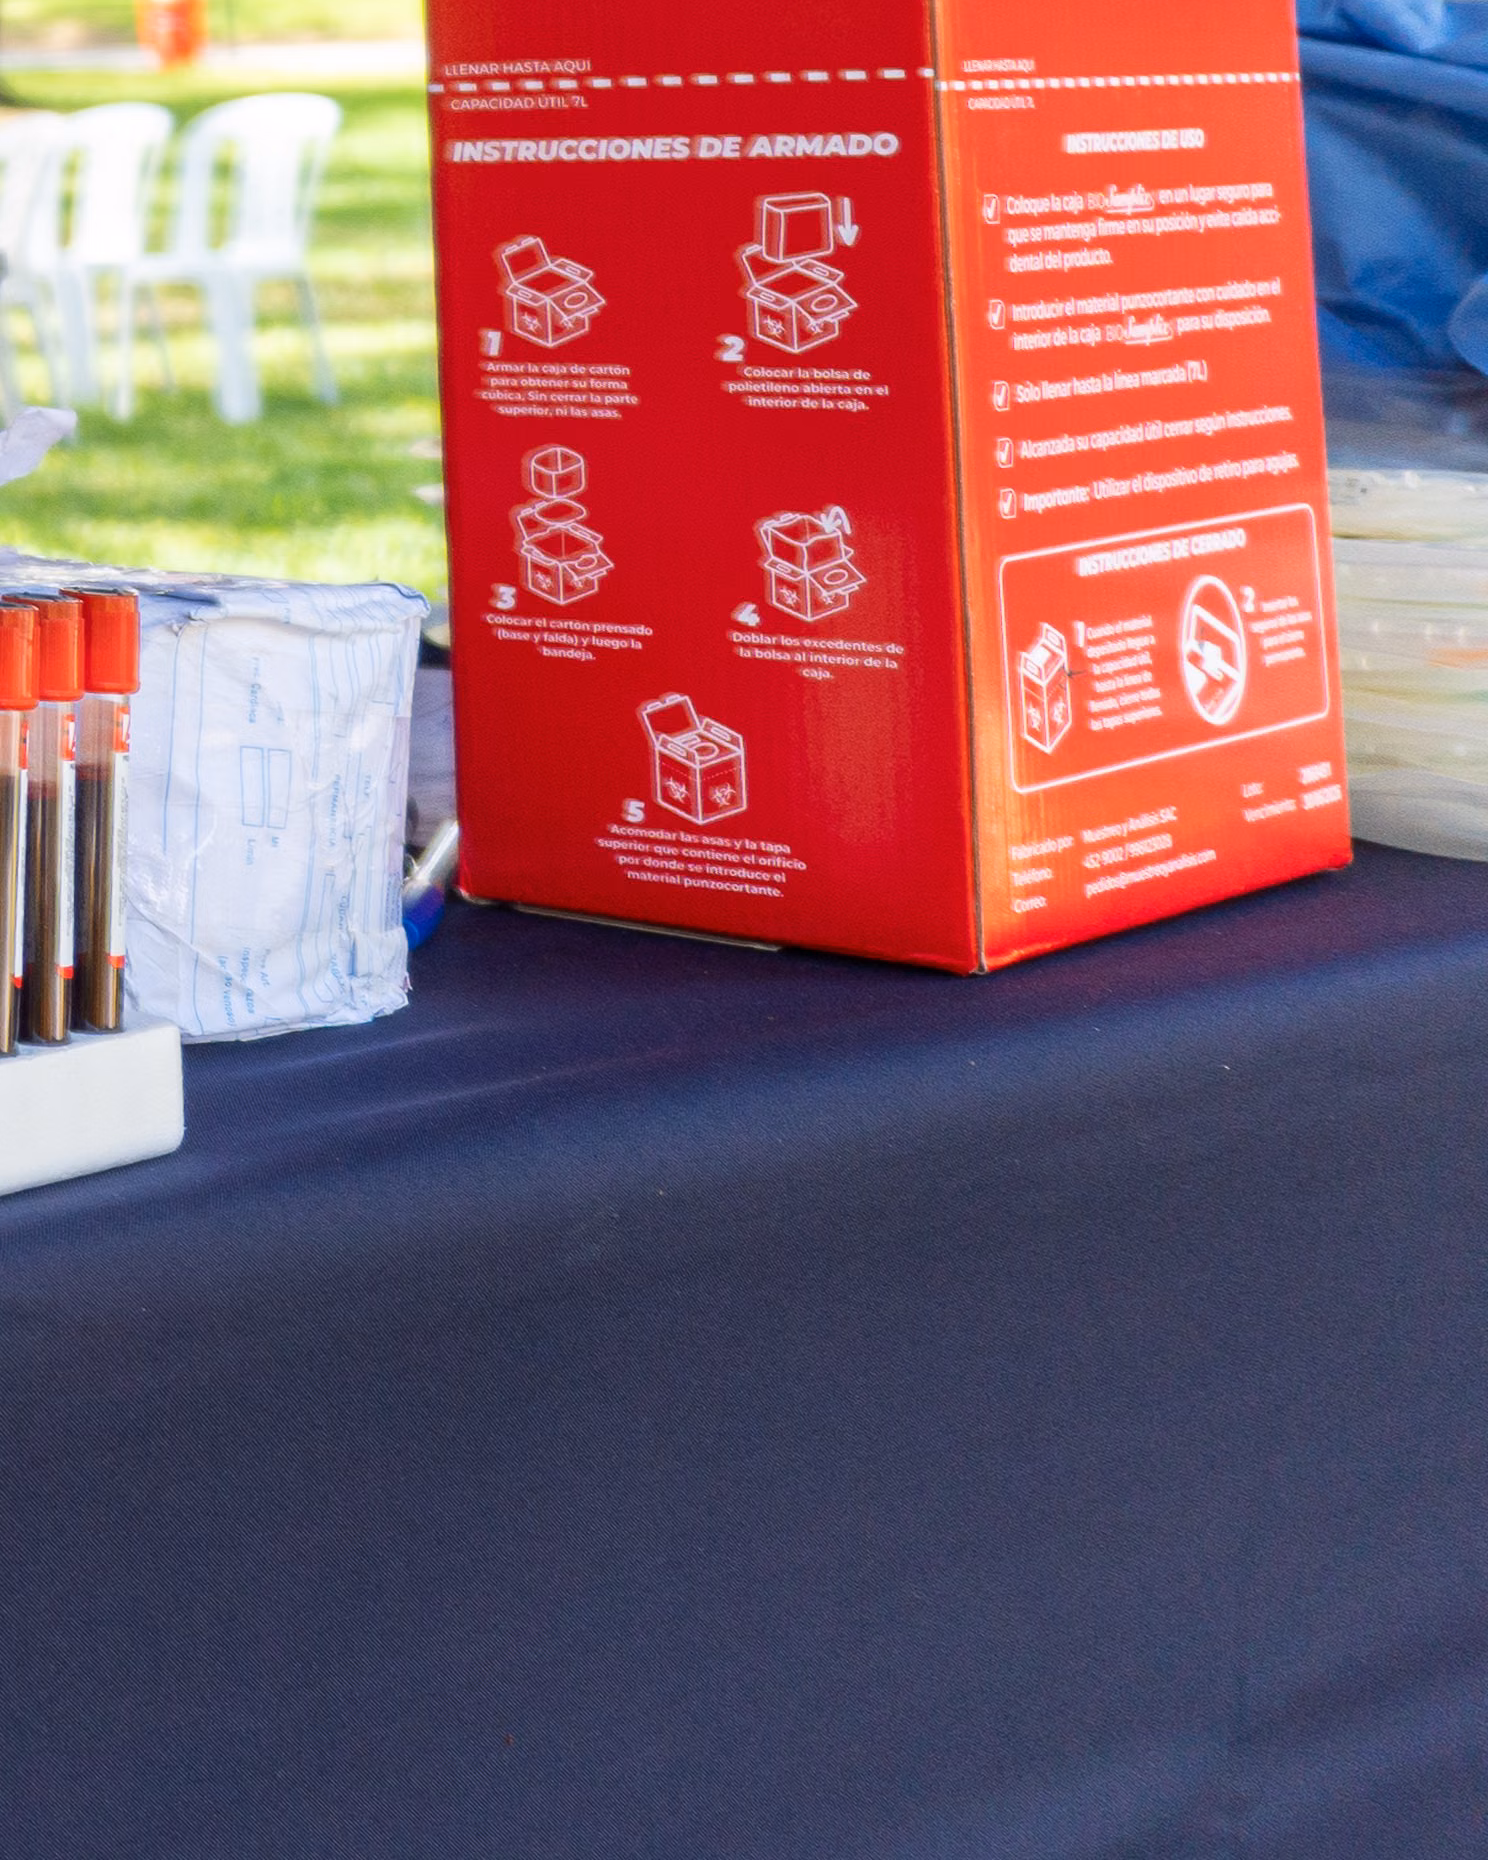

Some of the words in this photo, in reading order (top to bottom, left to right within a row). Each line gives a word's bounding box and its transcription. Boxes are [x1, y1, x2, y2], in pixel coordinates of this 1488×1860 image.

[444, 62, 499, 77] LLENAR
[502, 60, 550, 74] HASTA
[451, 96, 534, 111] CAPACIDAD
[571, 95, 588, 108] 7L
[453, 137, 691, 163] INSTRUCCIONES
[699, 135, 743, 159] DE
[749, 131, 899, 158] ARMADO
[1066, 131, 1160, 154] INSTRUCCIONES
[1161, 130, 1178, 148] DE
[1180, 128, 1204, 148] USO
[487, 331, 502, 356] 1
[721, 336, 745, 362] 2
[487, 362, 524, 373] Armar
[528, 363, 539, 373] la
[542, 364, 567, 375] caja
[570, 363, 586, 374] de
[743, 366, 793, 378] Colocar
[798, 368, 810, 378] la
[813, 369, 849, 379] bolsa
[853, 369, 871, 380] de
[490, 377, 518, 388] para
[520, 377, 569, 388] obtener
[572, 379, 587, 388] su
[590, 378, 628, 390] forma
[728, 381, 800, 394] polietileno
[803, 383, 852, 394] abierta
[855, 386, 873, 395] en
[875, 385, 889, 396] el
[527, 391, 547, 402] Sin
[550, 393, 586, 403] cerrar
[590, 392, 601, 403] la
[604, 394, 638, 406] parte
[748, 396, 797, 408] interior
[801, 397, 818, 409] de
[822, 398, 834, 409] la
[837, 399, 870, 412] caja.
[555, 406, 568, 416] ni
[570, 407, 587, 417] las
[1077, 546, 1170, 577] INSTRUCCIONES
[1172, 538, 1189, 559] DE
[1191, 528, 1247, 555] CERRADO
[496, 586, 517, 610] 3
[486, 613, 532, 627] Colocar
[535, 617, 547, 628] el
[593, 623, 653, 636] prensado
[735, 603, 761, 627] 4
[497, 629, 530, 640] (base
[533, 633, 540, 642] y
[543, 632, 578, 646] falda)
[582, 637, 589, 646] y
[592, 637, 628, 649] luego
[630, 638, 642, 649] la
[732, 632, 777, 644] Doblar
[781, 635, 800, 647] los
[804, 638, 882, 653] excedentes
[886, 643, 904, 654] de
[542, 647, 596, 661] bandeja.
[740, 647, 752, 658] la
[755, 648, 791, 661] bolsa
[794, 651, 806, 662] al
[809, 653, 860, 666] interior
[863, 657, 882, 668] de
[885, 658, 898, 669] la
[802, 667, 834, 680] caja.
[625, 801, 645, 823] 5
[610, 824, 677, 841] Acomodar
[680, 831, 698, 843] las
[701, 836, 731, 847] asas
[734, 840, 742, 850] y
[745, 838, 757, 850] la
[759, 841, 791, 855] tapa
[597, 837, 650, 852] superior
[653, 845, 678, 857] que
[681, 847, 740, 863] contiene
[743, 854, 756, 864] el
[758, 855, 807, 871] orificio
[618, 855, 640, 866] por
[643, 856, 684, 871] donde
[688, 862, 703, 873] se
[705, 863, 769, 881] introduce
[773, 872, 786, 883] el
[627, 870, 681, 885] material
[684, 877, 784, 898] punzocortante.
